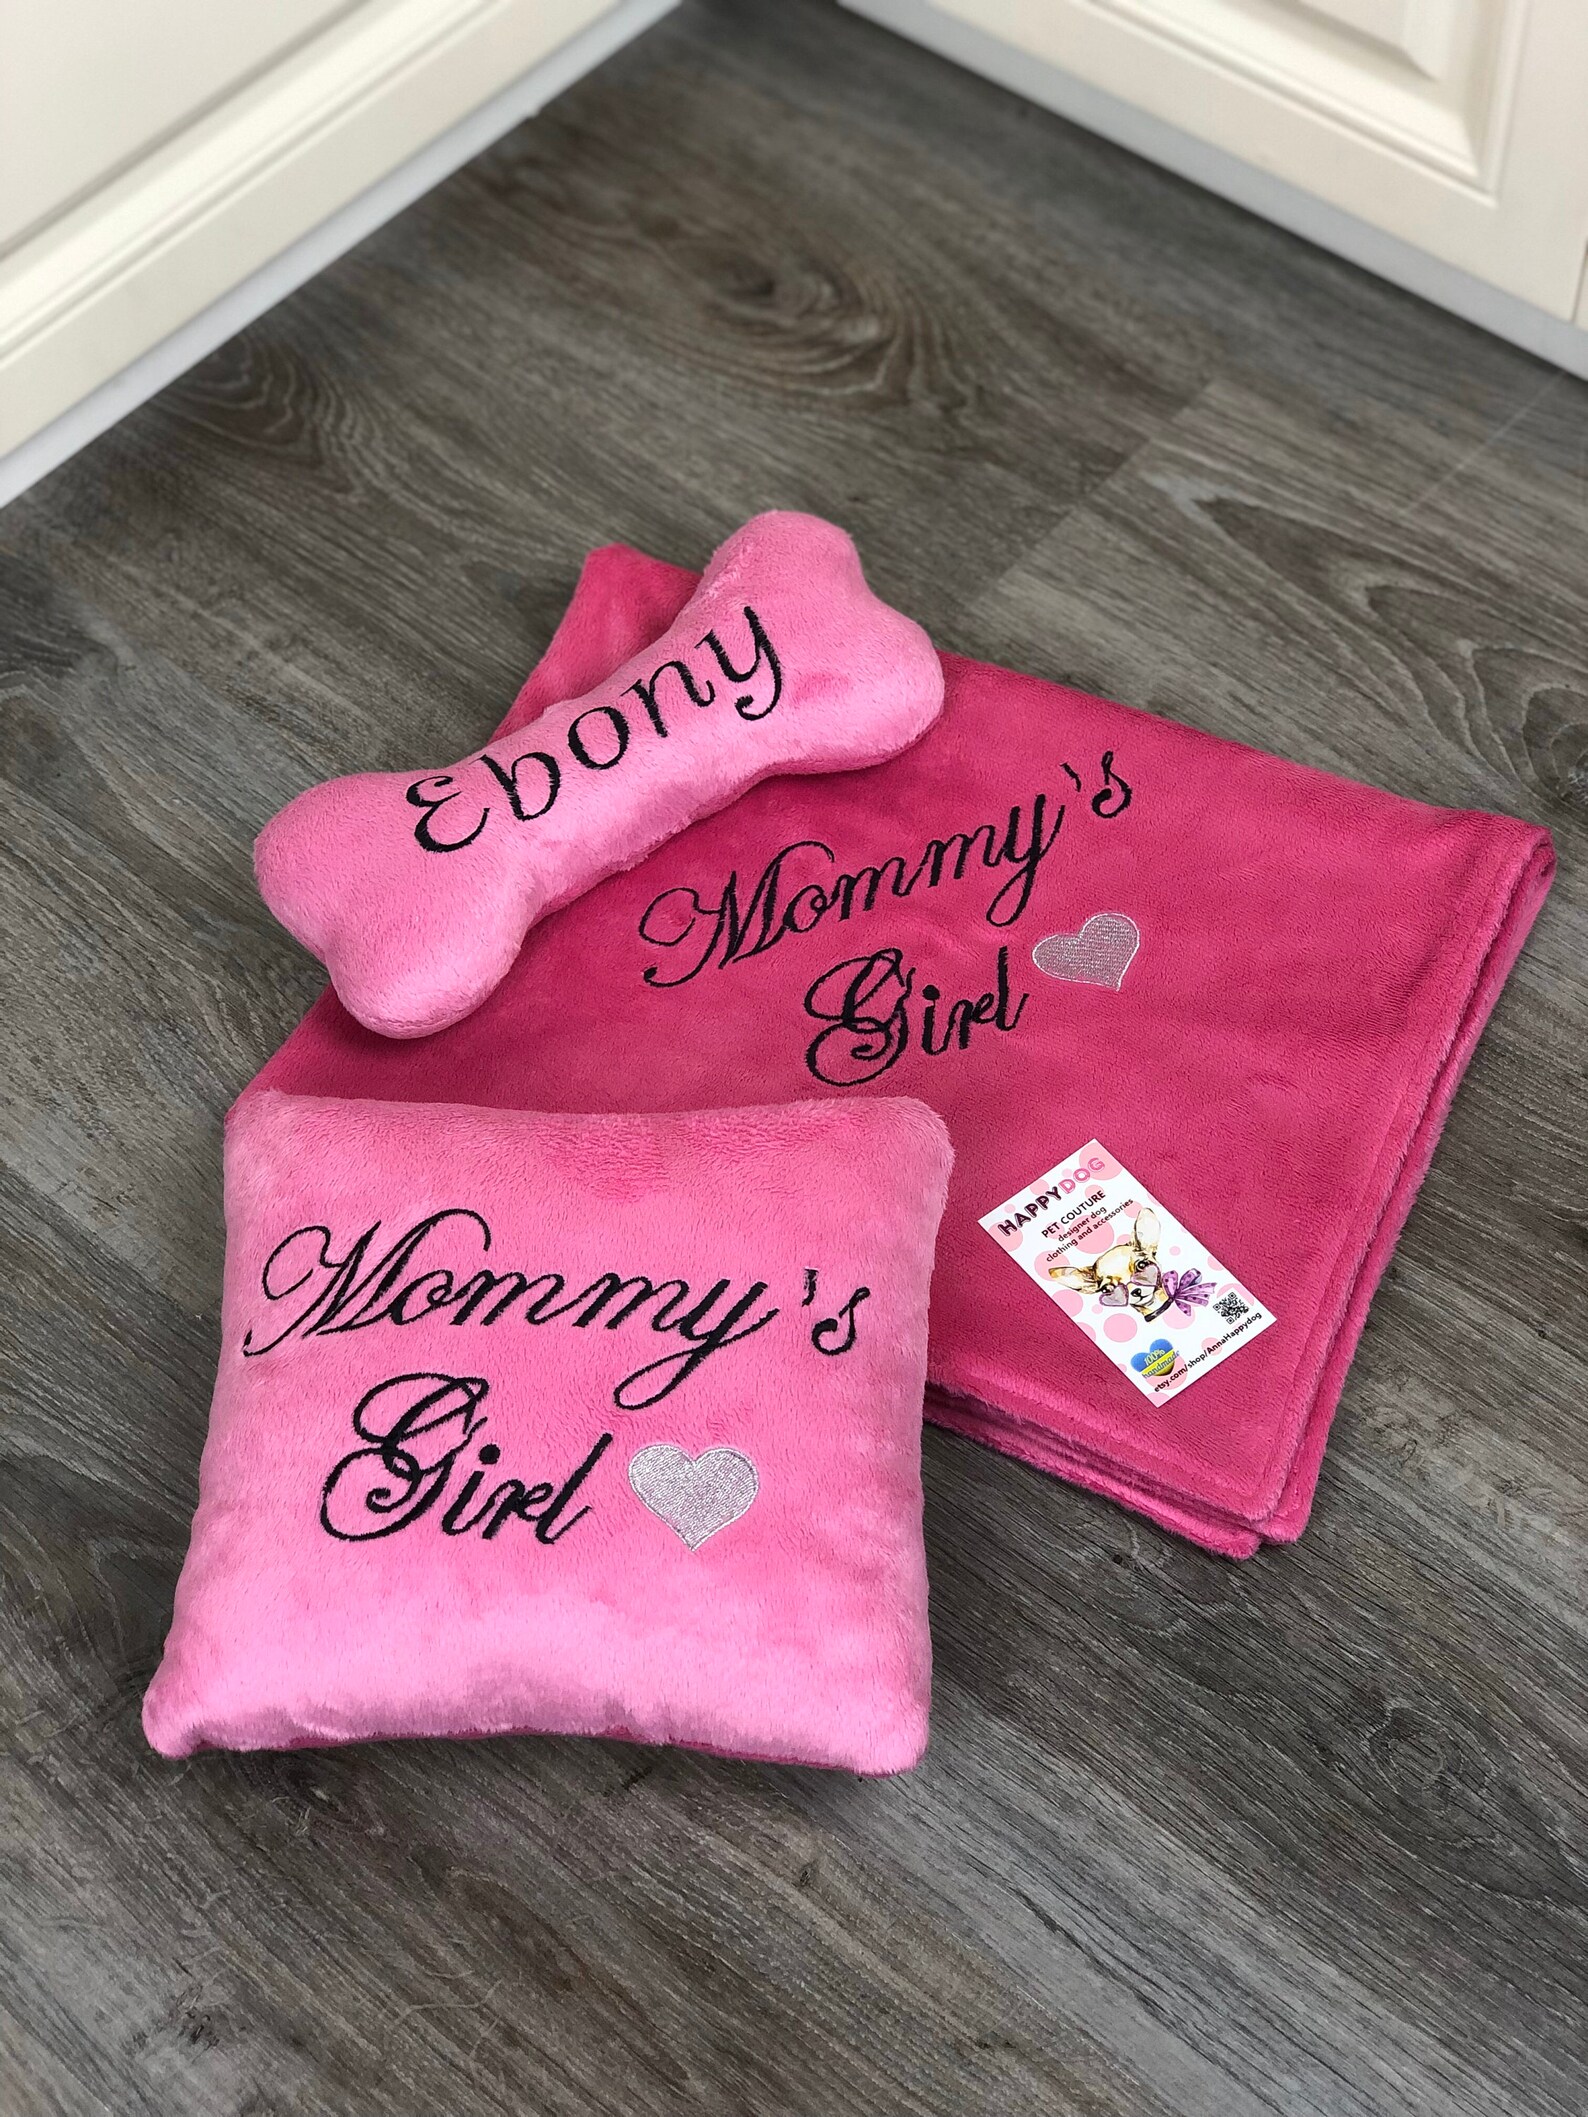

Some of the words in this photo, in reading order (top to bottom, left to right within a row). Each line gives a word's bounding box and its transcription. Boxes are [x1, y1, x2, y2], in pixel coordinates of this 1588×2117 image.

[406, 606, 782, 853] Ebony
[638, 751, 1132, 987] Mommy's
[804, 946, 1029, 1087] Girl
[1041, 1221, 1060, 1239] PET
[1060, 1190, 1106, 1226] COUTURE
[1046, 1238, 1078, 1263] clothing
[1077, 1226, 1093, 1242] and
[1092, 1198, 1134, 1231] accessories
[1058, 1213, 1091, 1243] designer
[1090, 1206, 1107, 1224] dog
[243, 1208, 870, 1410] Mommy's
[1142, 1350, 1180, 1380] handmade
[1143, 1349, 1165, 1368] 100%
[1154, 1311, 1263, 1393] etsy.com/shop/AnnaHappydog
[321, 1372, 613, 1545] Girl
